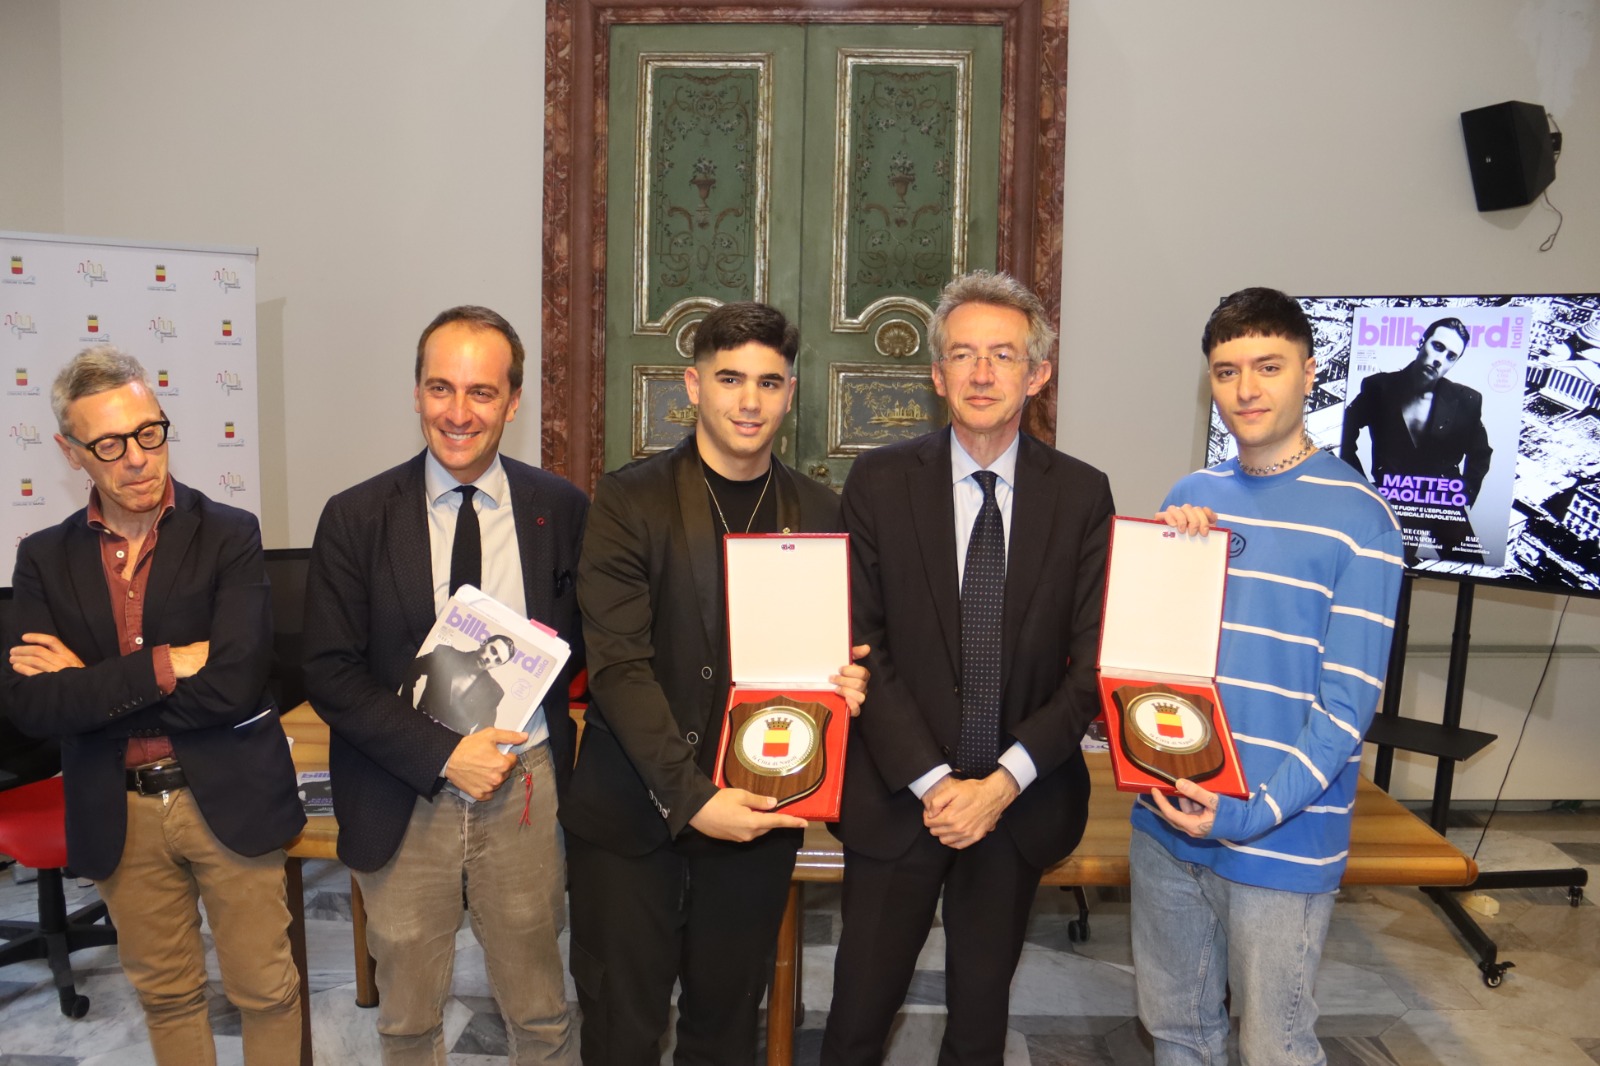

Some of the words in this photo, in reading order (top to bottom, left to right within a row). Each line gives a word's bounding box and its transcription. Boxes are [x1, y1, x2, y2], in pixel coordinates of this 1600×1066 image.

[1358, 315, 1510, 348] billbrd
[1510, 317, 1524, 348] Italia
[1382, 474, 1464, 493] MATTEO
[1378, 487, 1467, 507] PAOLILLO
[1424, 507, 1461, 516] L'ESPLOSIVA
[1425, 514, 1466, 522] NAPOLETANA
[1414, 536, 1436, 544] NAPOLI
[445, 605, 542, 674] billbrd
[534, 659, 549, 679] Italia
